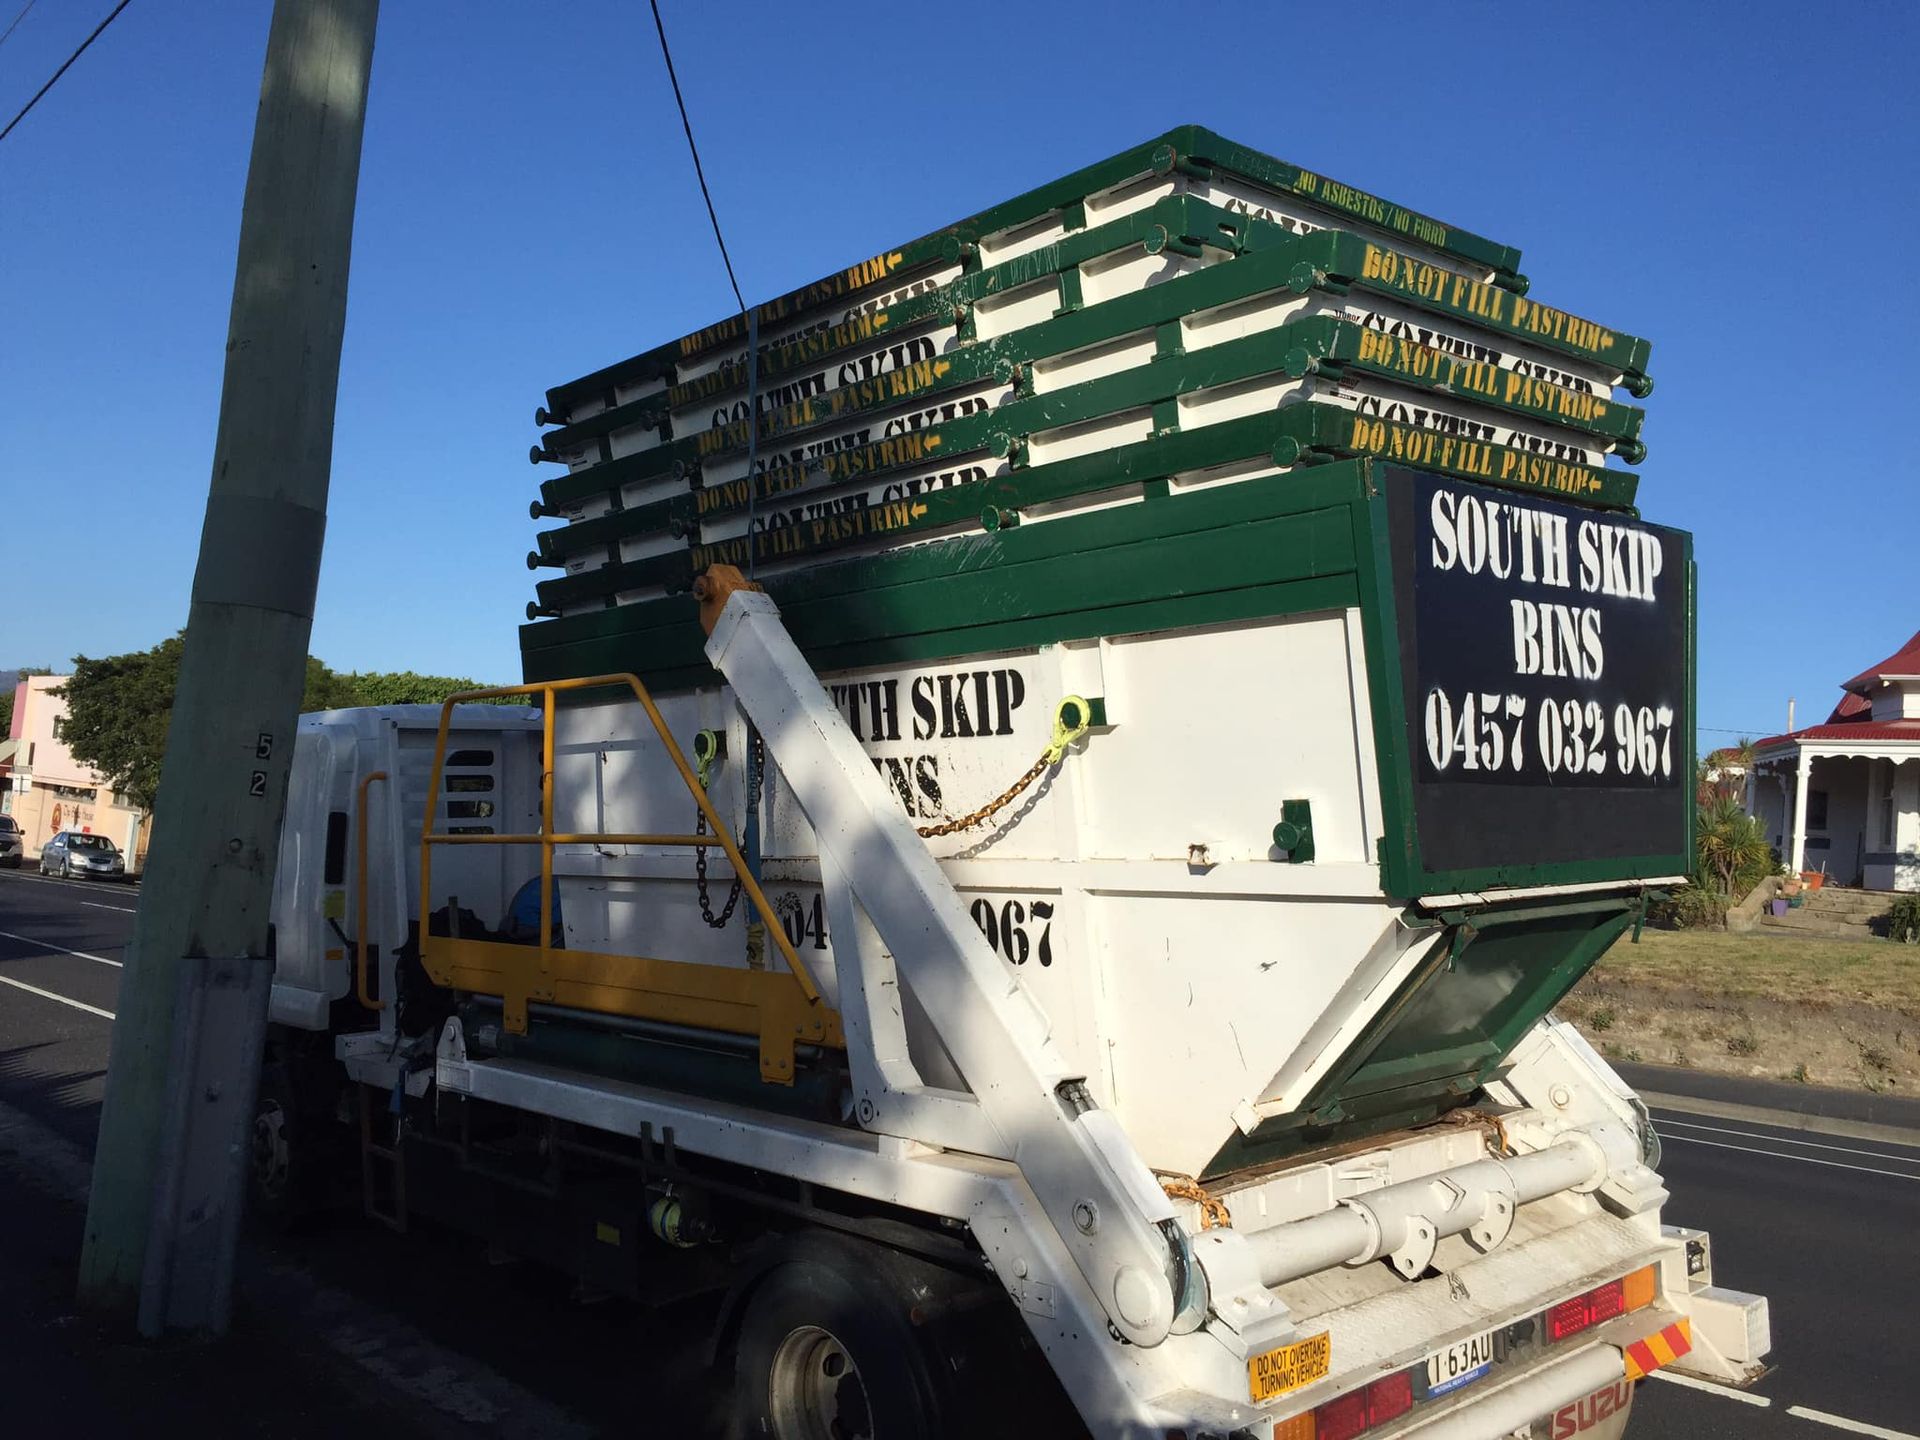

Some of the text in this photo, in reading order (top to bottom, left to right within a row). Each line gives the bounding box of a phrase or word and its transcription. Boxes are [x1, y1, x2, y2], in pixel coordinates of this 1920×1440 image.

[1300, 171, 1317, 194] NO
[1321, 180, 1385, 223] ASBESTOS
[1393, 208, 1410, 233] NO
[847, 255, 887, 291] RIM
[1362, 243, 1398, 285] DO
[1399, 256, 1449, 302] NOT
[1451, 275, 1504, 321] FILL
[1511, 296, 1567, 340] PAST
[1566, 314, 1601, 353] RIM
[834, 315, 873, 348] RIM
[889, 359, 935, 397] RIM
[1358, 327, 1394, 367] DO
[1395, 338, 1444, 380] NOT
[1448, 360, 1498, 397] FILL
[1505, 373, 1559, 411] PAST
[1558, 388, 1595, 421] RIM
[823, 445, 877, 478] PAST
[879, 431, 924, 466] RIM
[1350, 416, 1386, 454] DO
[1387, 426, 1438, 463] NOT
[1440, 438, 1493, 476] FILL
[1501, 450, 1555, 488] PAST
[811, 510, 865, 545] PAST
[869, 501, 911, 532] RIM
[1431, 489, 1663, 602] SOUTH SKIP
[1510, 599, 1604, 681] BINS
[911, 669, 1026, 741] SKIP
[1425, 687, 1674, 777] 0457 032 967
[1257, 1336, 1327, 1376] DO NOT OVERTAKE
[1260, 1356, 1325, 1396] TURNING VEHICLE
